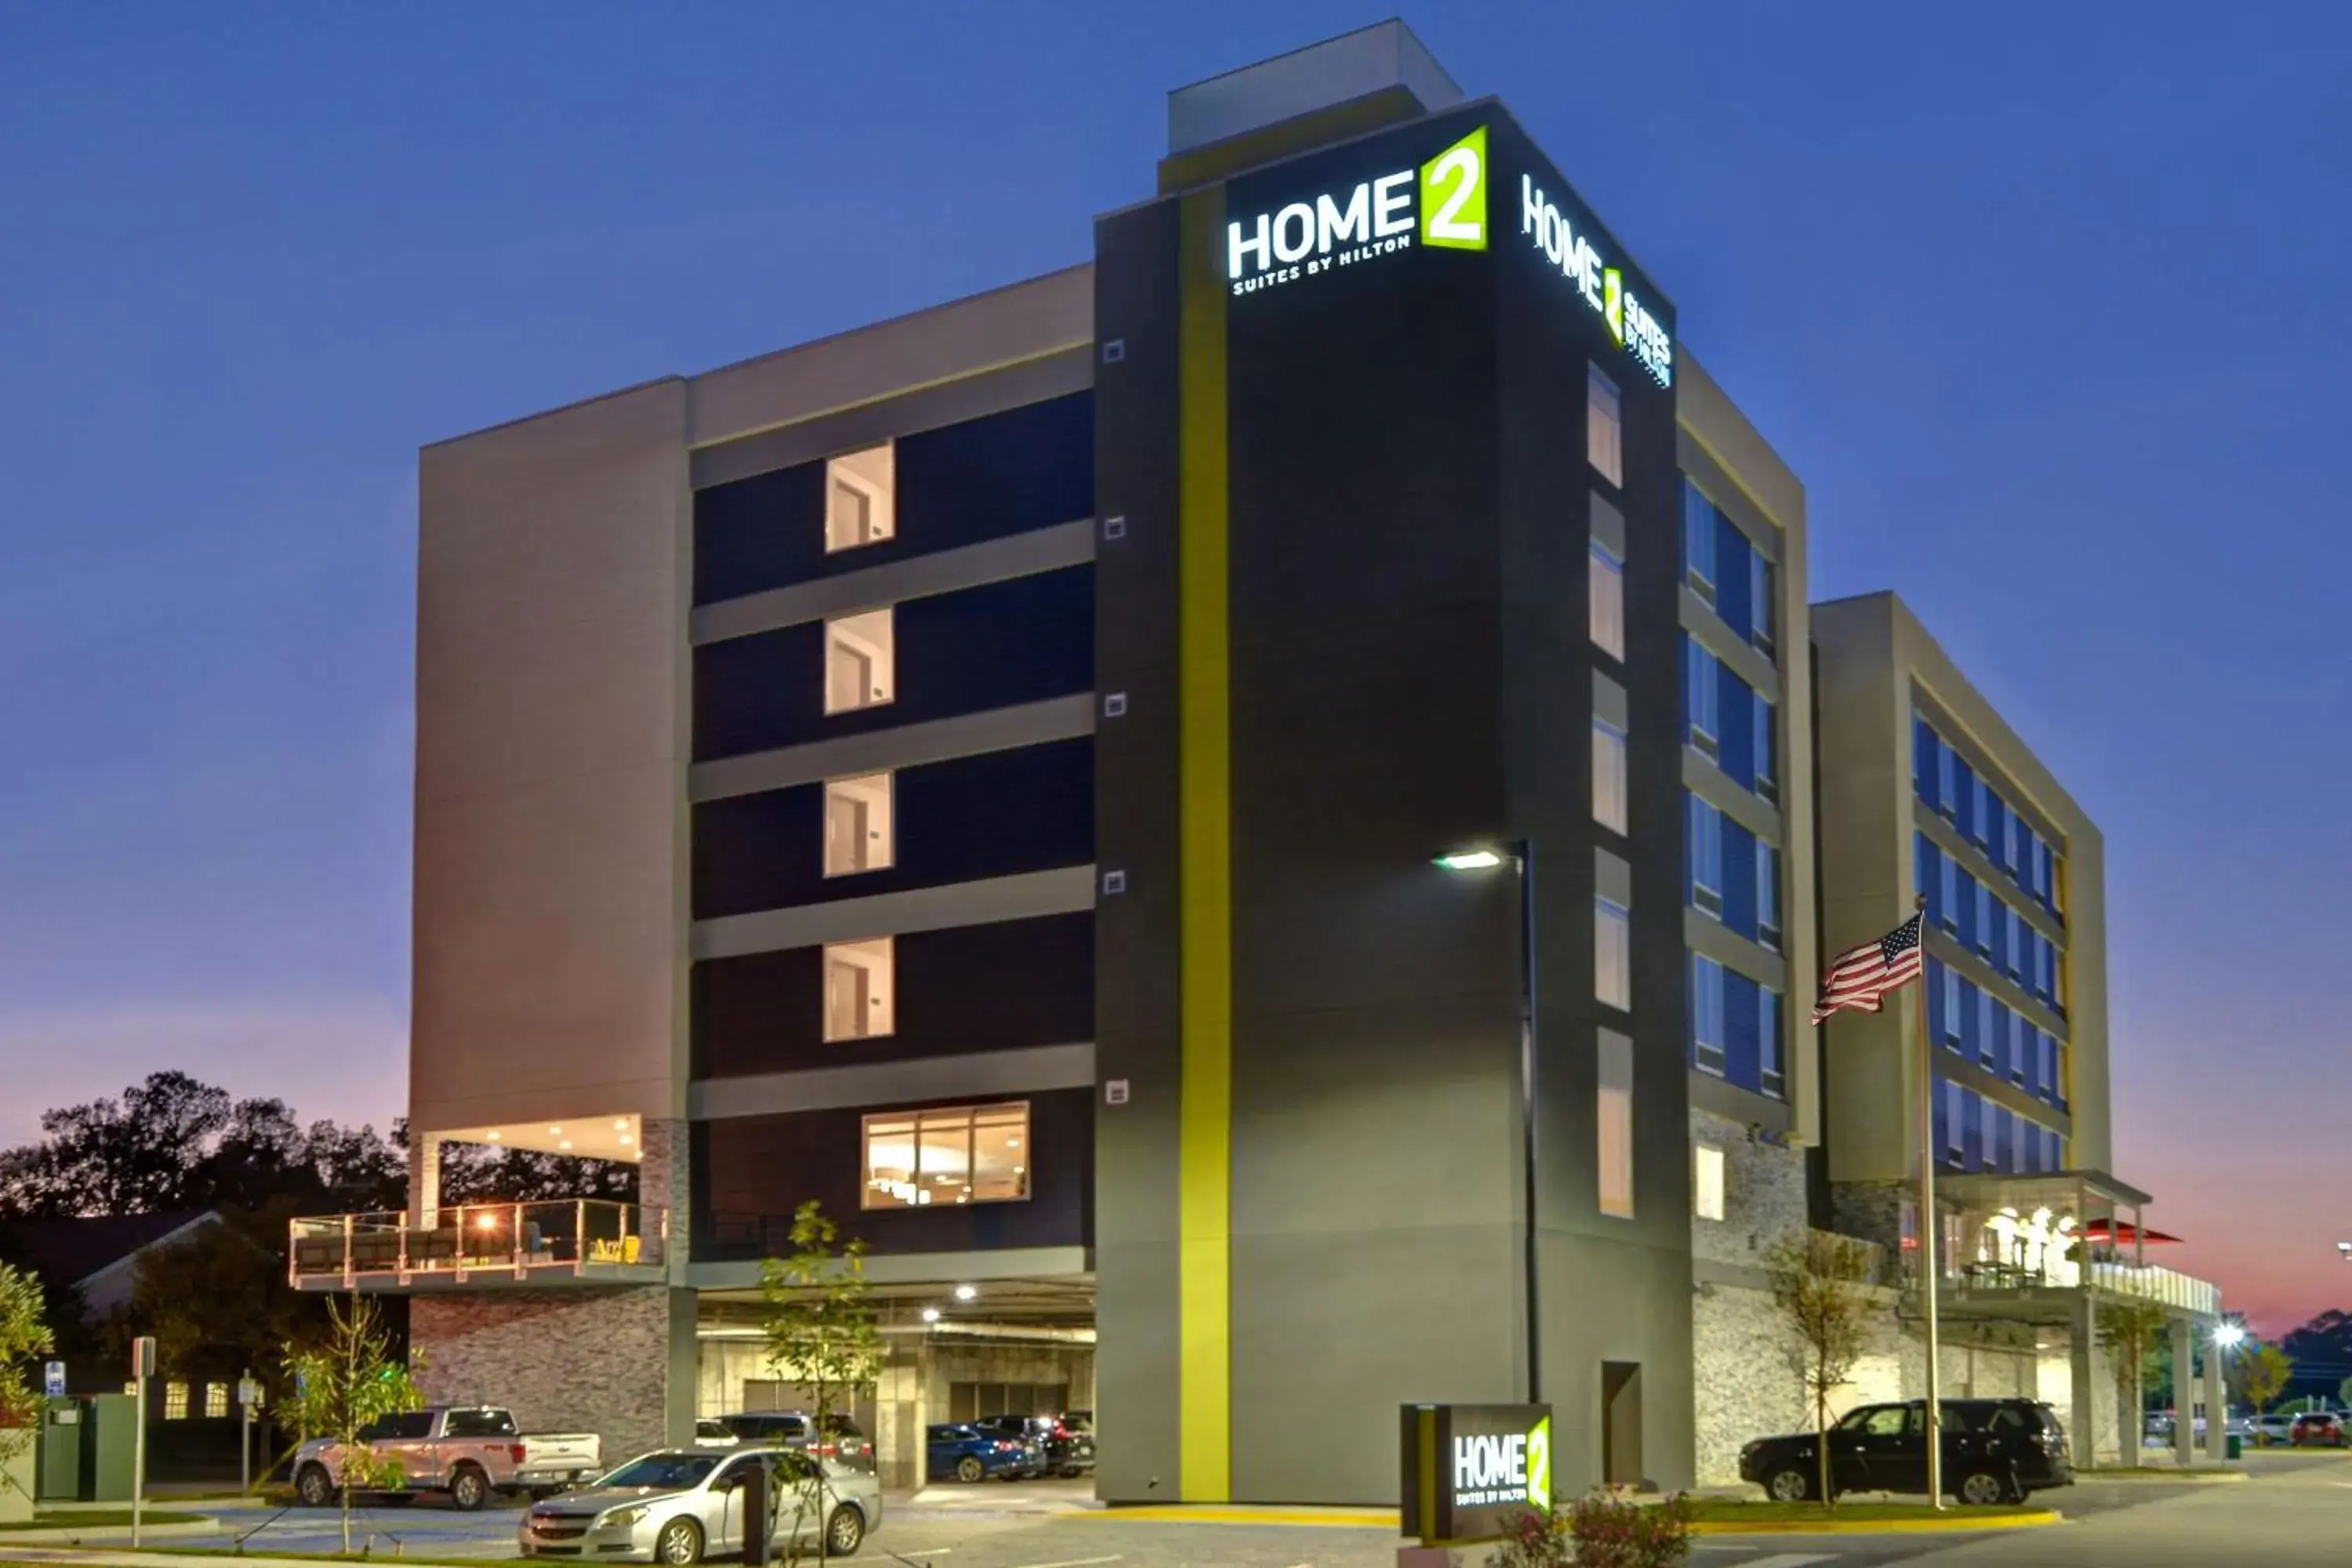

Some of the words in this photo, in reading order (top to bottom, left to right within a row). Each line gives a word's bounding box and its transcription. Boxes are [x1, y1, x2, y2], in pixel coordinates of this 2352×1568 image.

[1229, 169, 1415, 278] HOME
[1429, 147, 1481, 240] 2
[1233, 267, 1301, 296] SUITES
[1308, 256, 1332, 275] BY
[1339, 235, 1410, 266] HILTON
[1523, 174, 1602, 312] HOME
[1606, 272, 1622, 343] 2
[1454, 1434, 1527, 1488] HOME
[1529, 1429, 1549, 1511] 2
